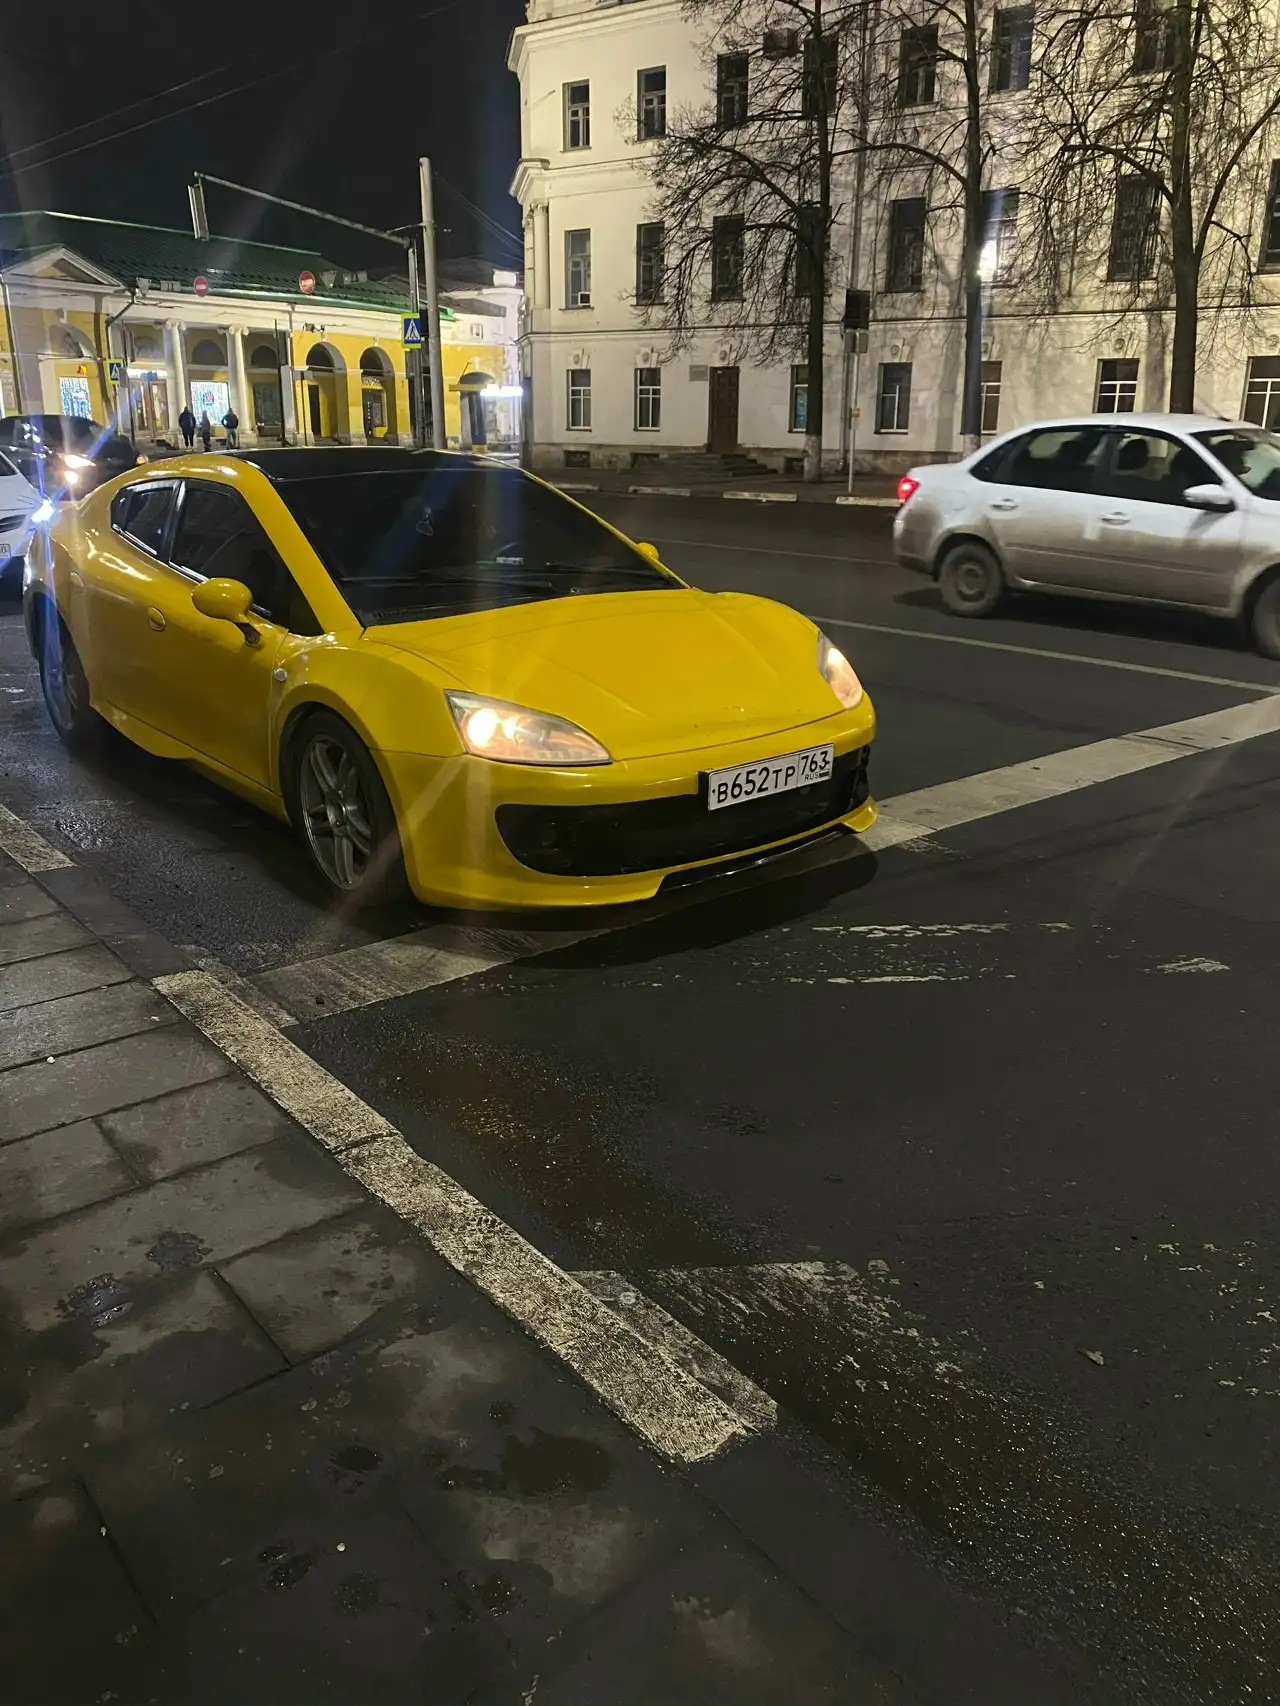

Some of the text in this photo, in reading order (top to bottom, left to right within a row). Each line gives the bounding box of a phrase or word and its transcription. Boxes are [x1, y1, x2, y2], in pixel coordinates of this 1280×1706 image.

[717, 751, 829, 803] В652ТР 763
[804, 771, 819, 782] RUS
